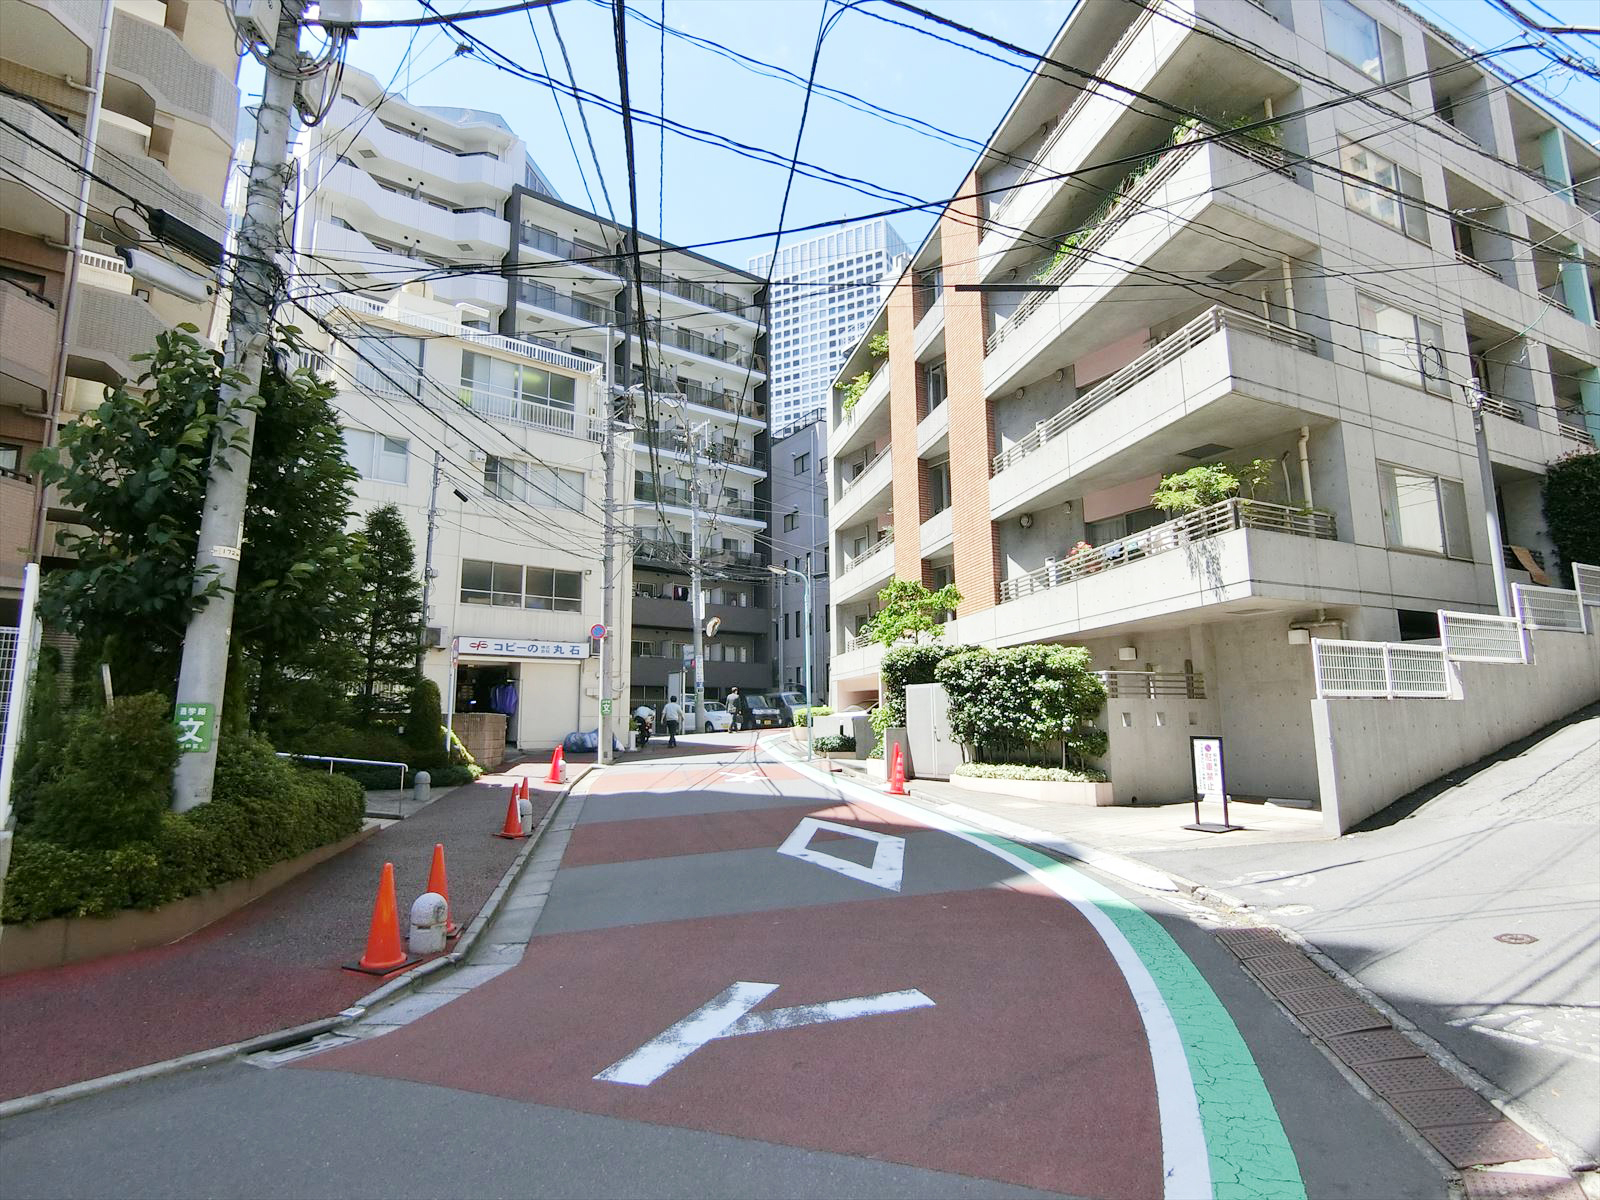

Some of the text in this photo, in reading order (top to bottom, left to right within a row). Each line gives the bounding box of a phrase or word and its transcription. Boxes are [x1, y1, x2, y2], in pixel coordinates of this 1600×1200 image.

[553, 644, 581, 655] 丸石
[177, 717, 205, 743] 文
[1205, 752, 1215, 791] 駐車禁止
